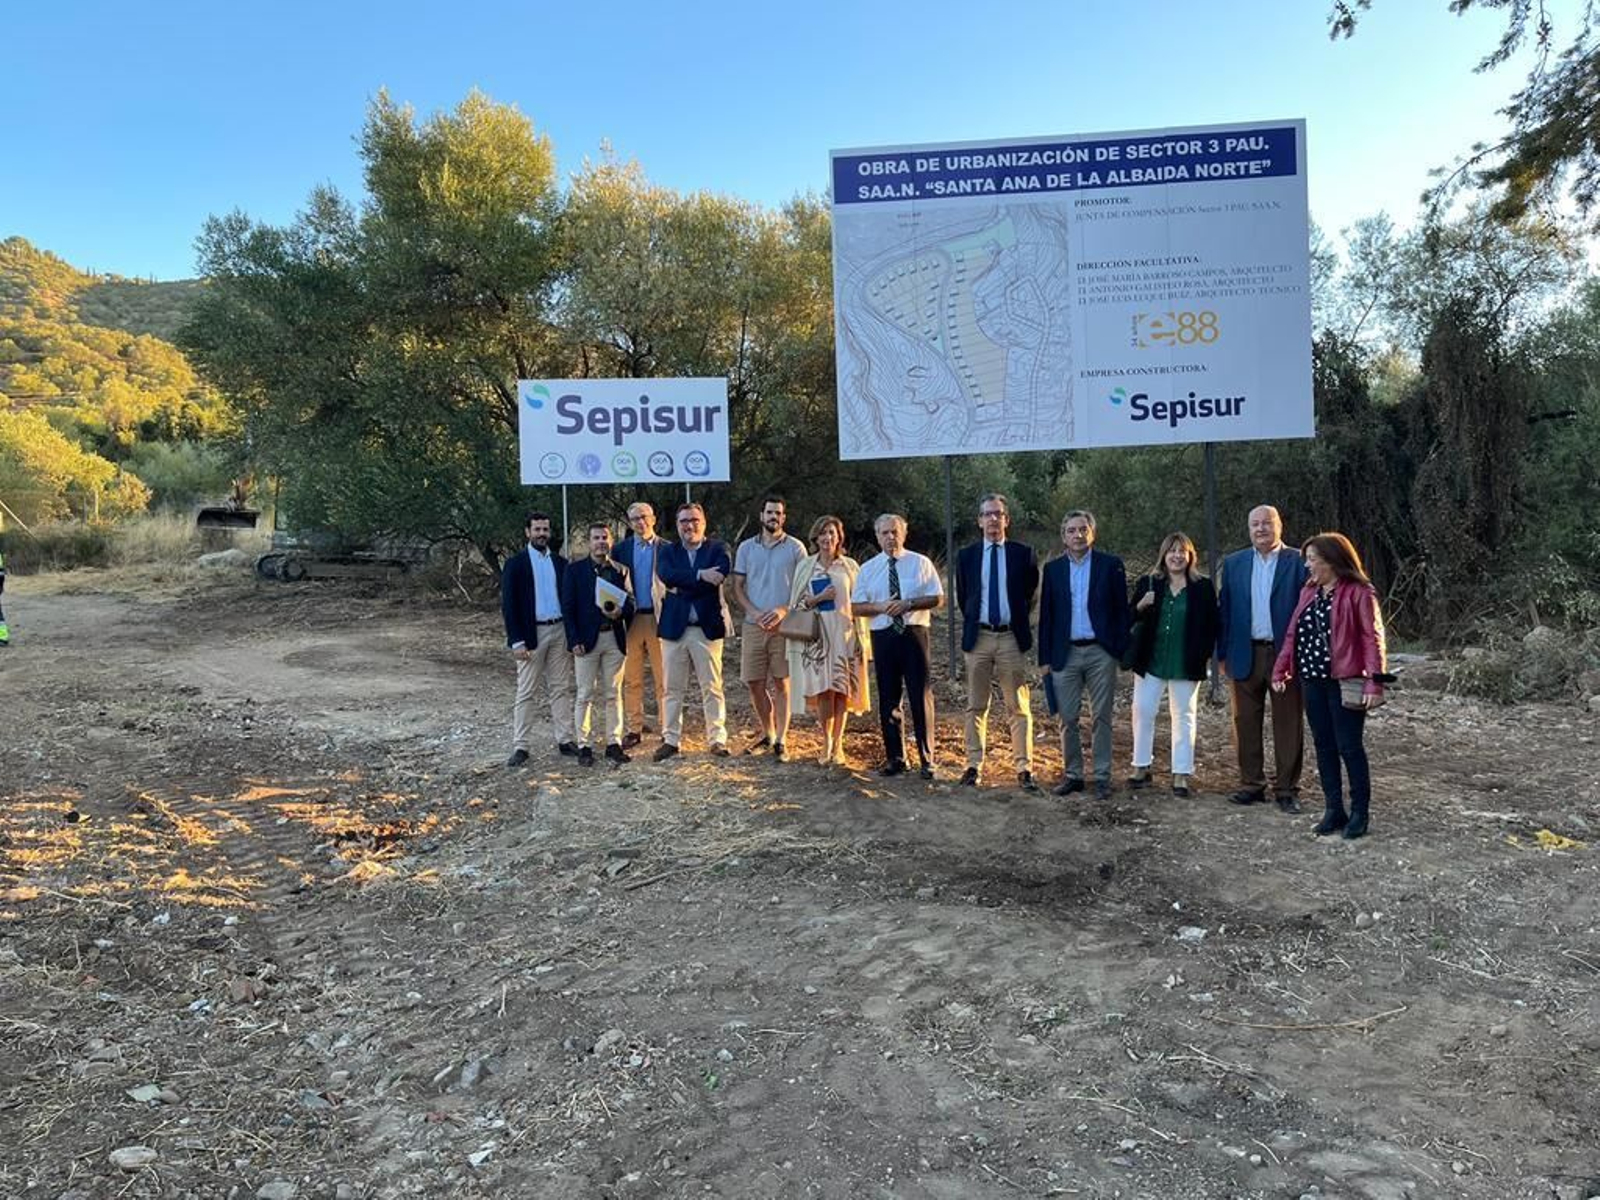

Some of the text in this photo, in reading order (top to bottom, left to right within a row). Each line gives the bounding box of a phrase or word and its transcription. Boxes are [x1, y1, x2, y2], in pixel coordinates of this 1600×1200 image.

[858, 136, 1269, 176] OBRA DE URBANIZACIÓN DE SECTOR 3 PAU.
[858, 159, 1271, 199] SAA.N. “SANTA ANA DE LA ALBAIDA NORTE”
[1080, 368, 1125, 379] EMPRESA
[556, 394, 721, 446] Sepisur
[1130, 391, 1246, 428] Sepisur
